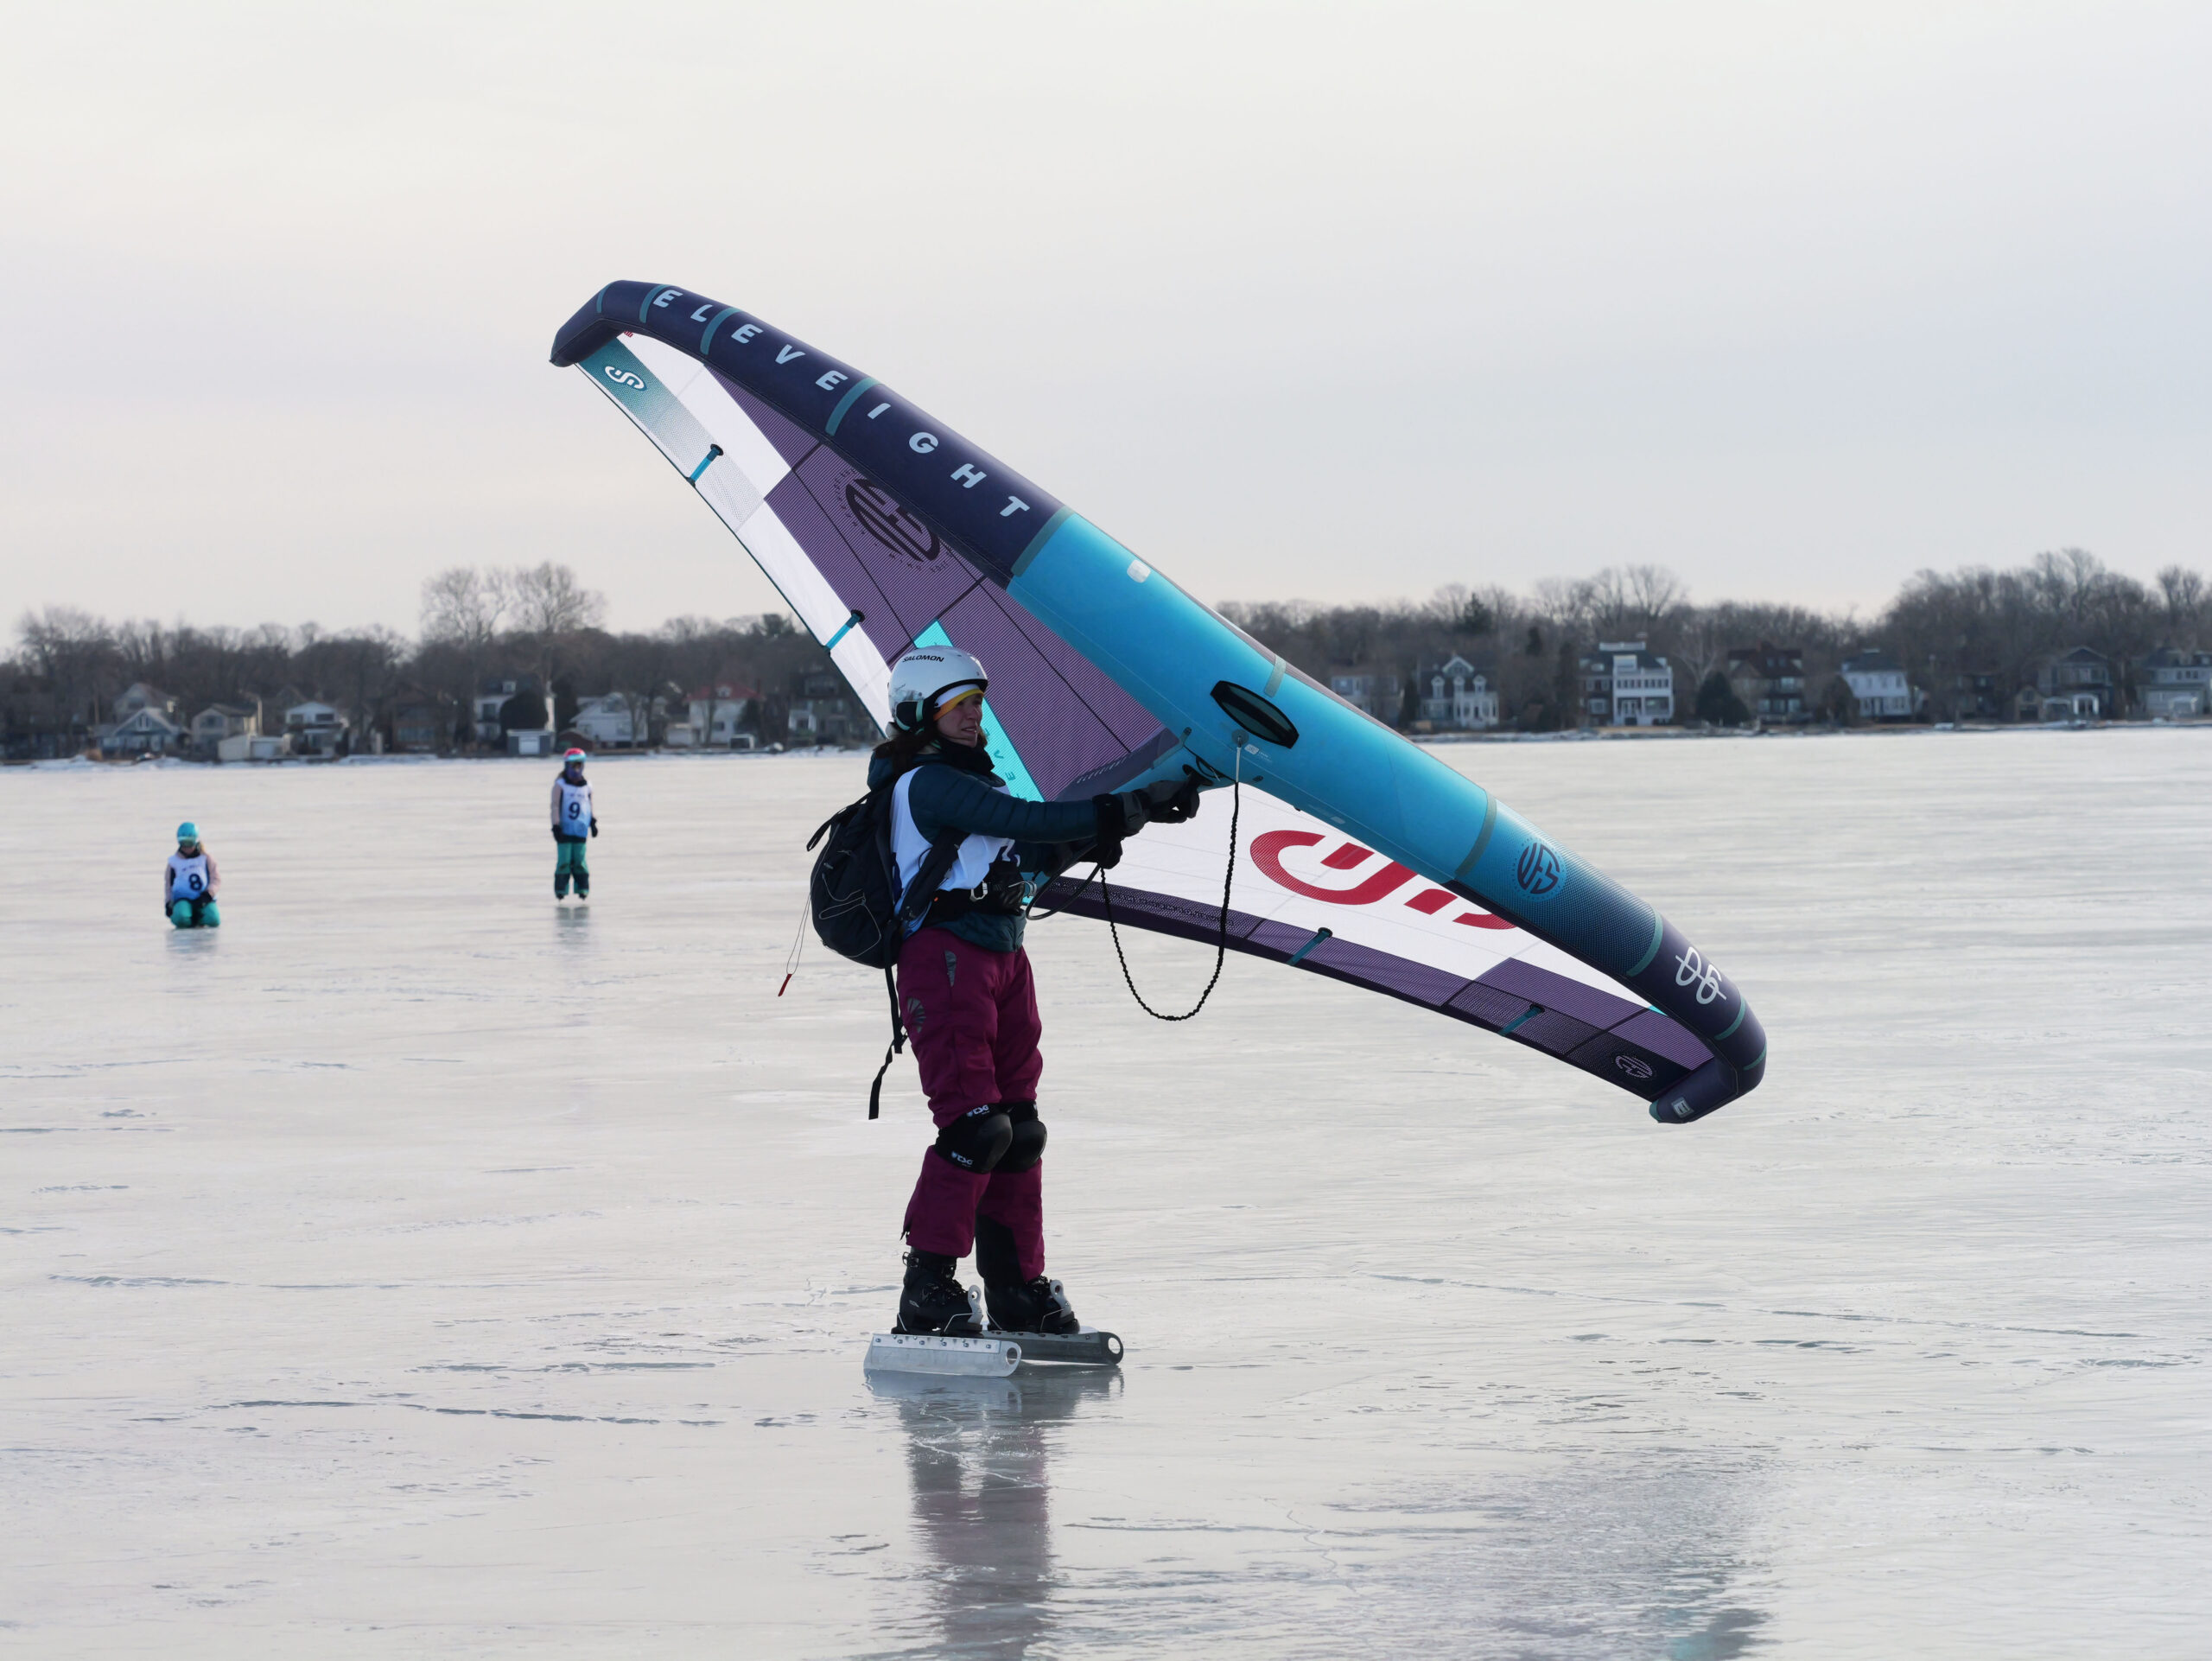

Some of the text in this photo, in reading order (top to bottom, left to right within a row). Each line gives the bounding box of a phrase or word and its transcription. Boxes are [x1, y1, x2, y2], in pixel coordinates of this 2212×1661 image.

[652, 290, 1031, 518] ELEVEIGHT
[903, 654, 945, 663] SALOMON
[569, 802, 581, 821] 9
[188, 874, 203, 892] 8
